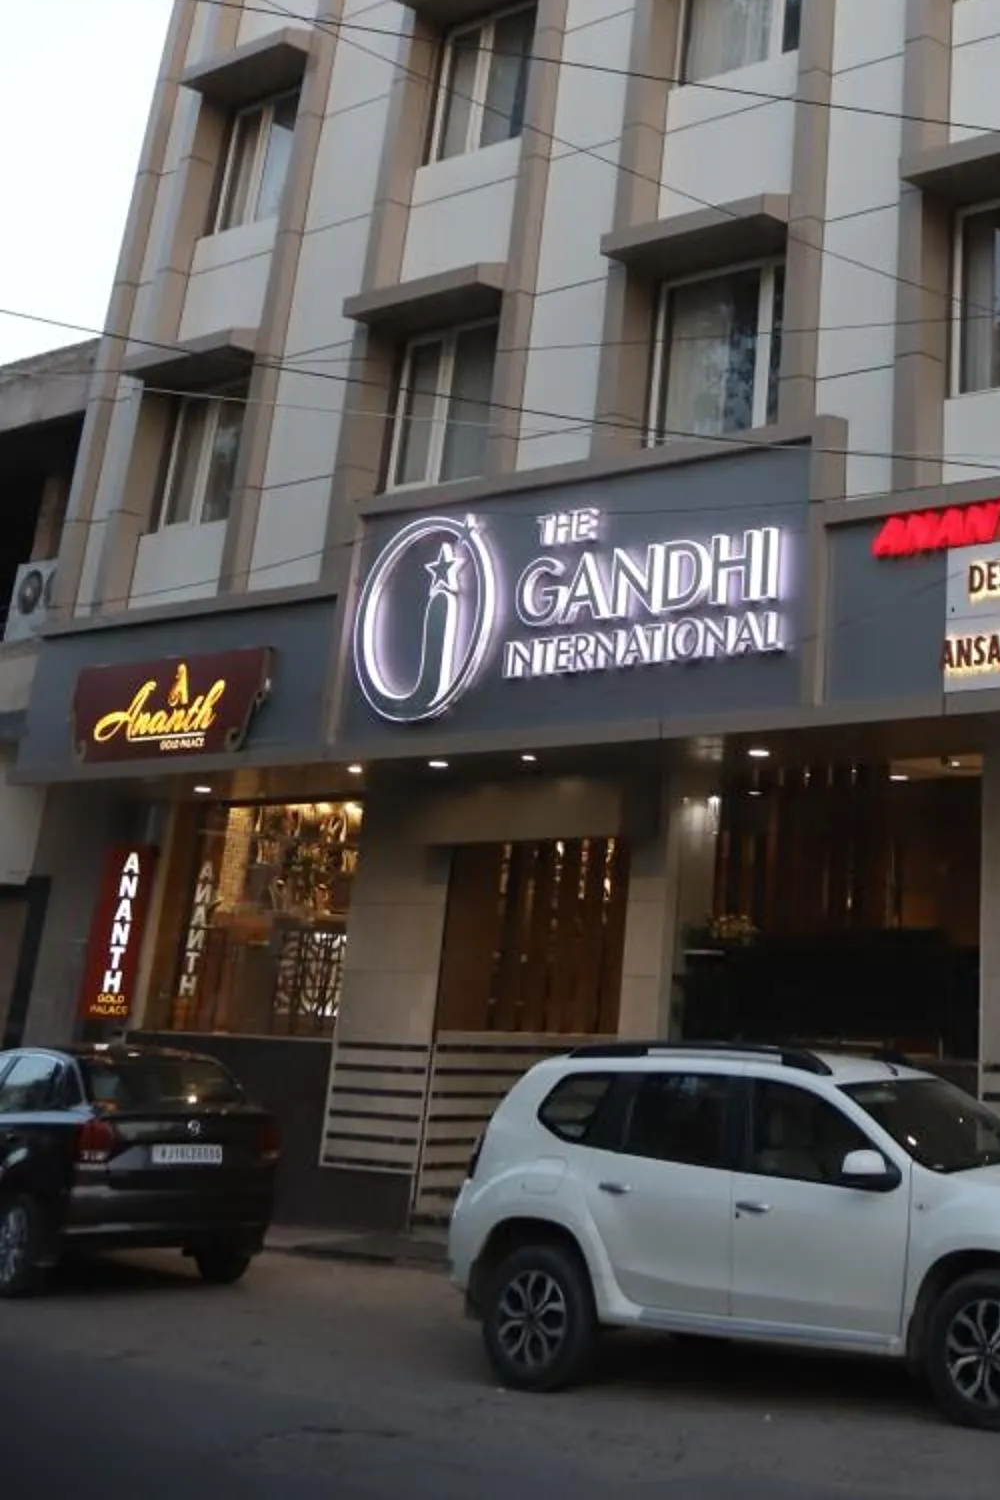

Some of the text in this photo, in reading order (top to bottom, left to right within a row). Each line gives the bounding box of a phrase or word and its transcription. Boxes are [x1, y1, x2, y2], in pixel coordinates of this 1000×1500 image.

[537, 508, 600, 546] THE
[515, 526, 779, 627] GANDHI
[502, 610, 786, 679] INTERNATIONAL
[94, 679, 225, 742] Ananth
[102, 852, 140, 993] ANANTH
[97, 994, 125, 1003] GOLD
